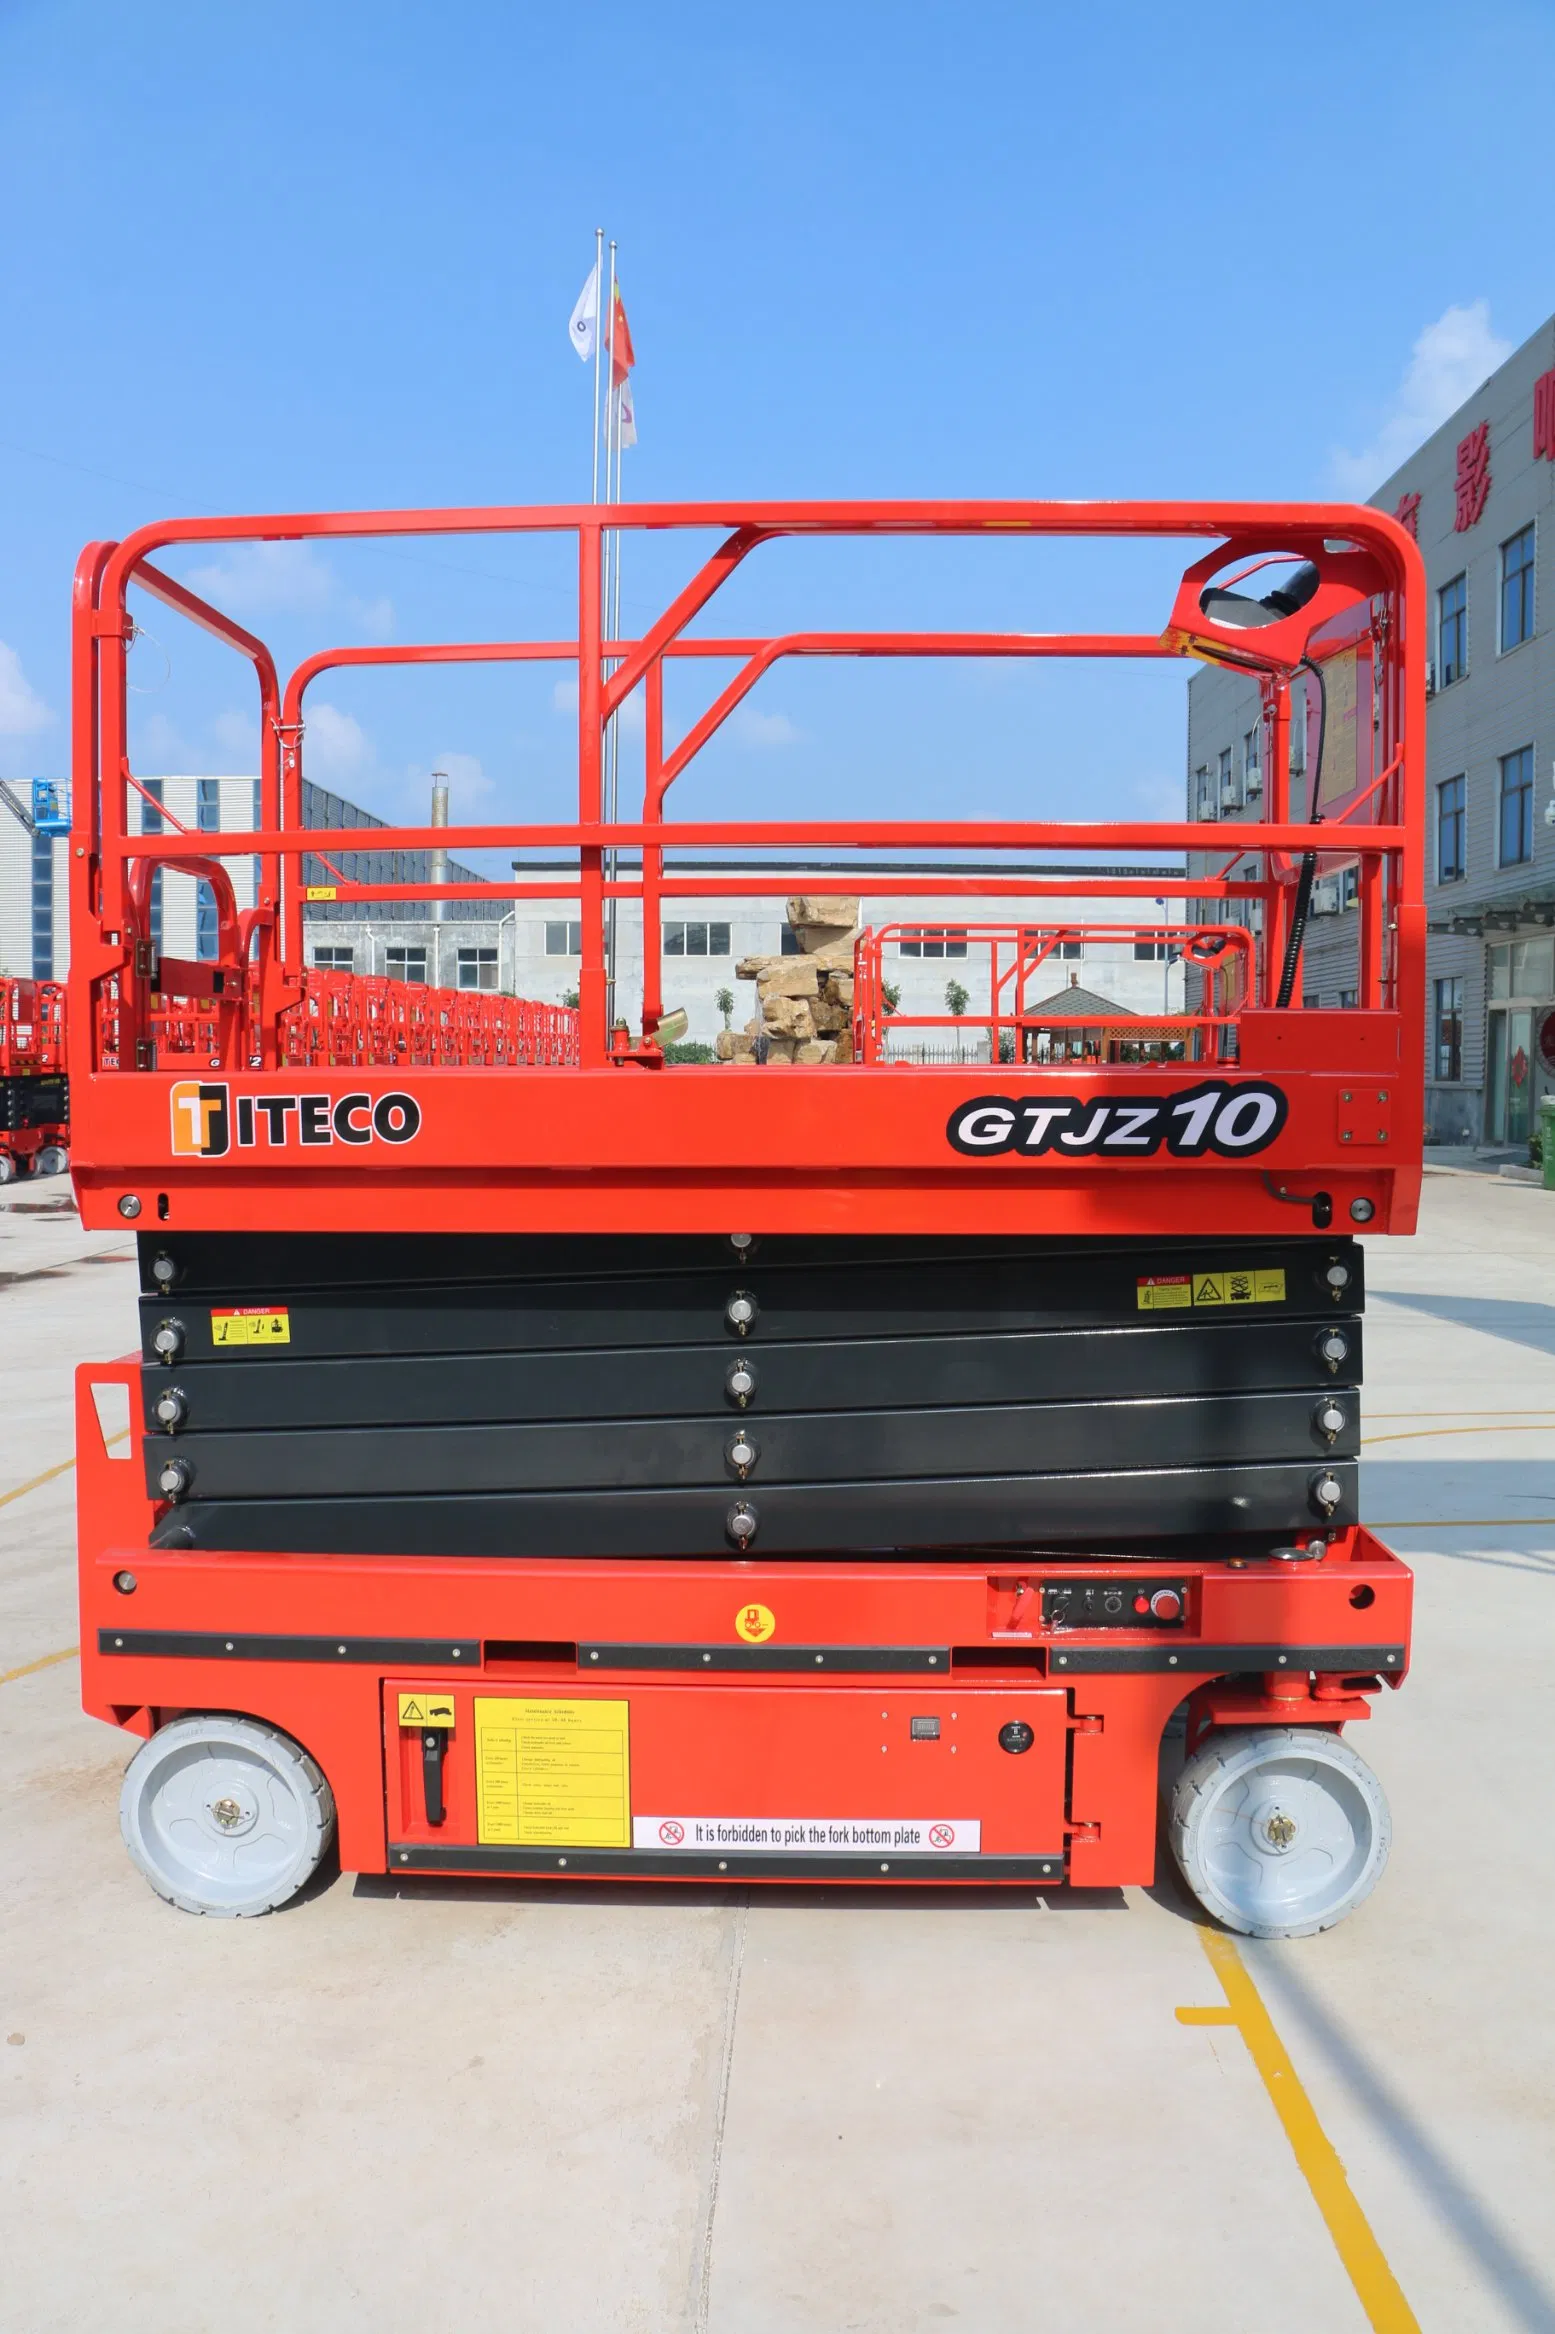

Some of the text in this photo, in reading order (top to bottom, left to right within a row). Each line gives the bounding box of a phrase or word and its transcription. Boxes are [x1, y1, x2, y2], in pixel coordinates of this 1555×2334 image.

[237, 1093, 422, 1147] ITECO
[1157, 1276, 1185, 1284] DANGER
[243, 1308, 270, 1316] DANGER
[696, 1824, 920, 1848] It is forbidden to pick the fork bottom plate
